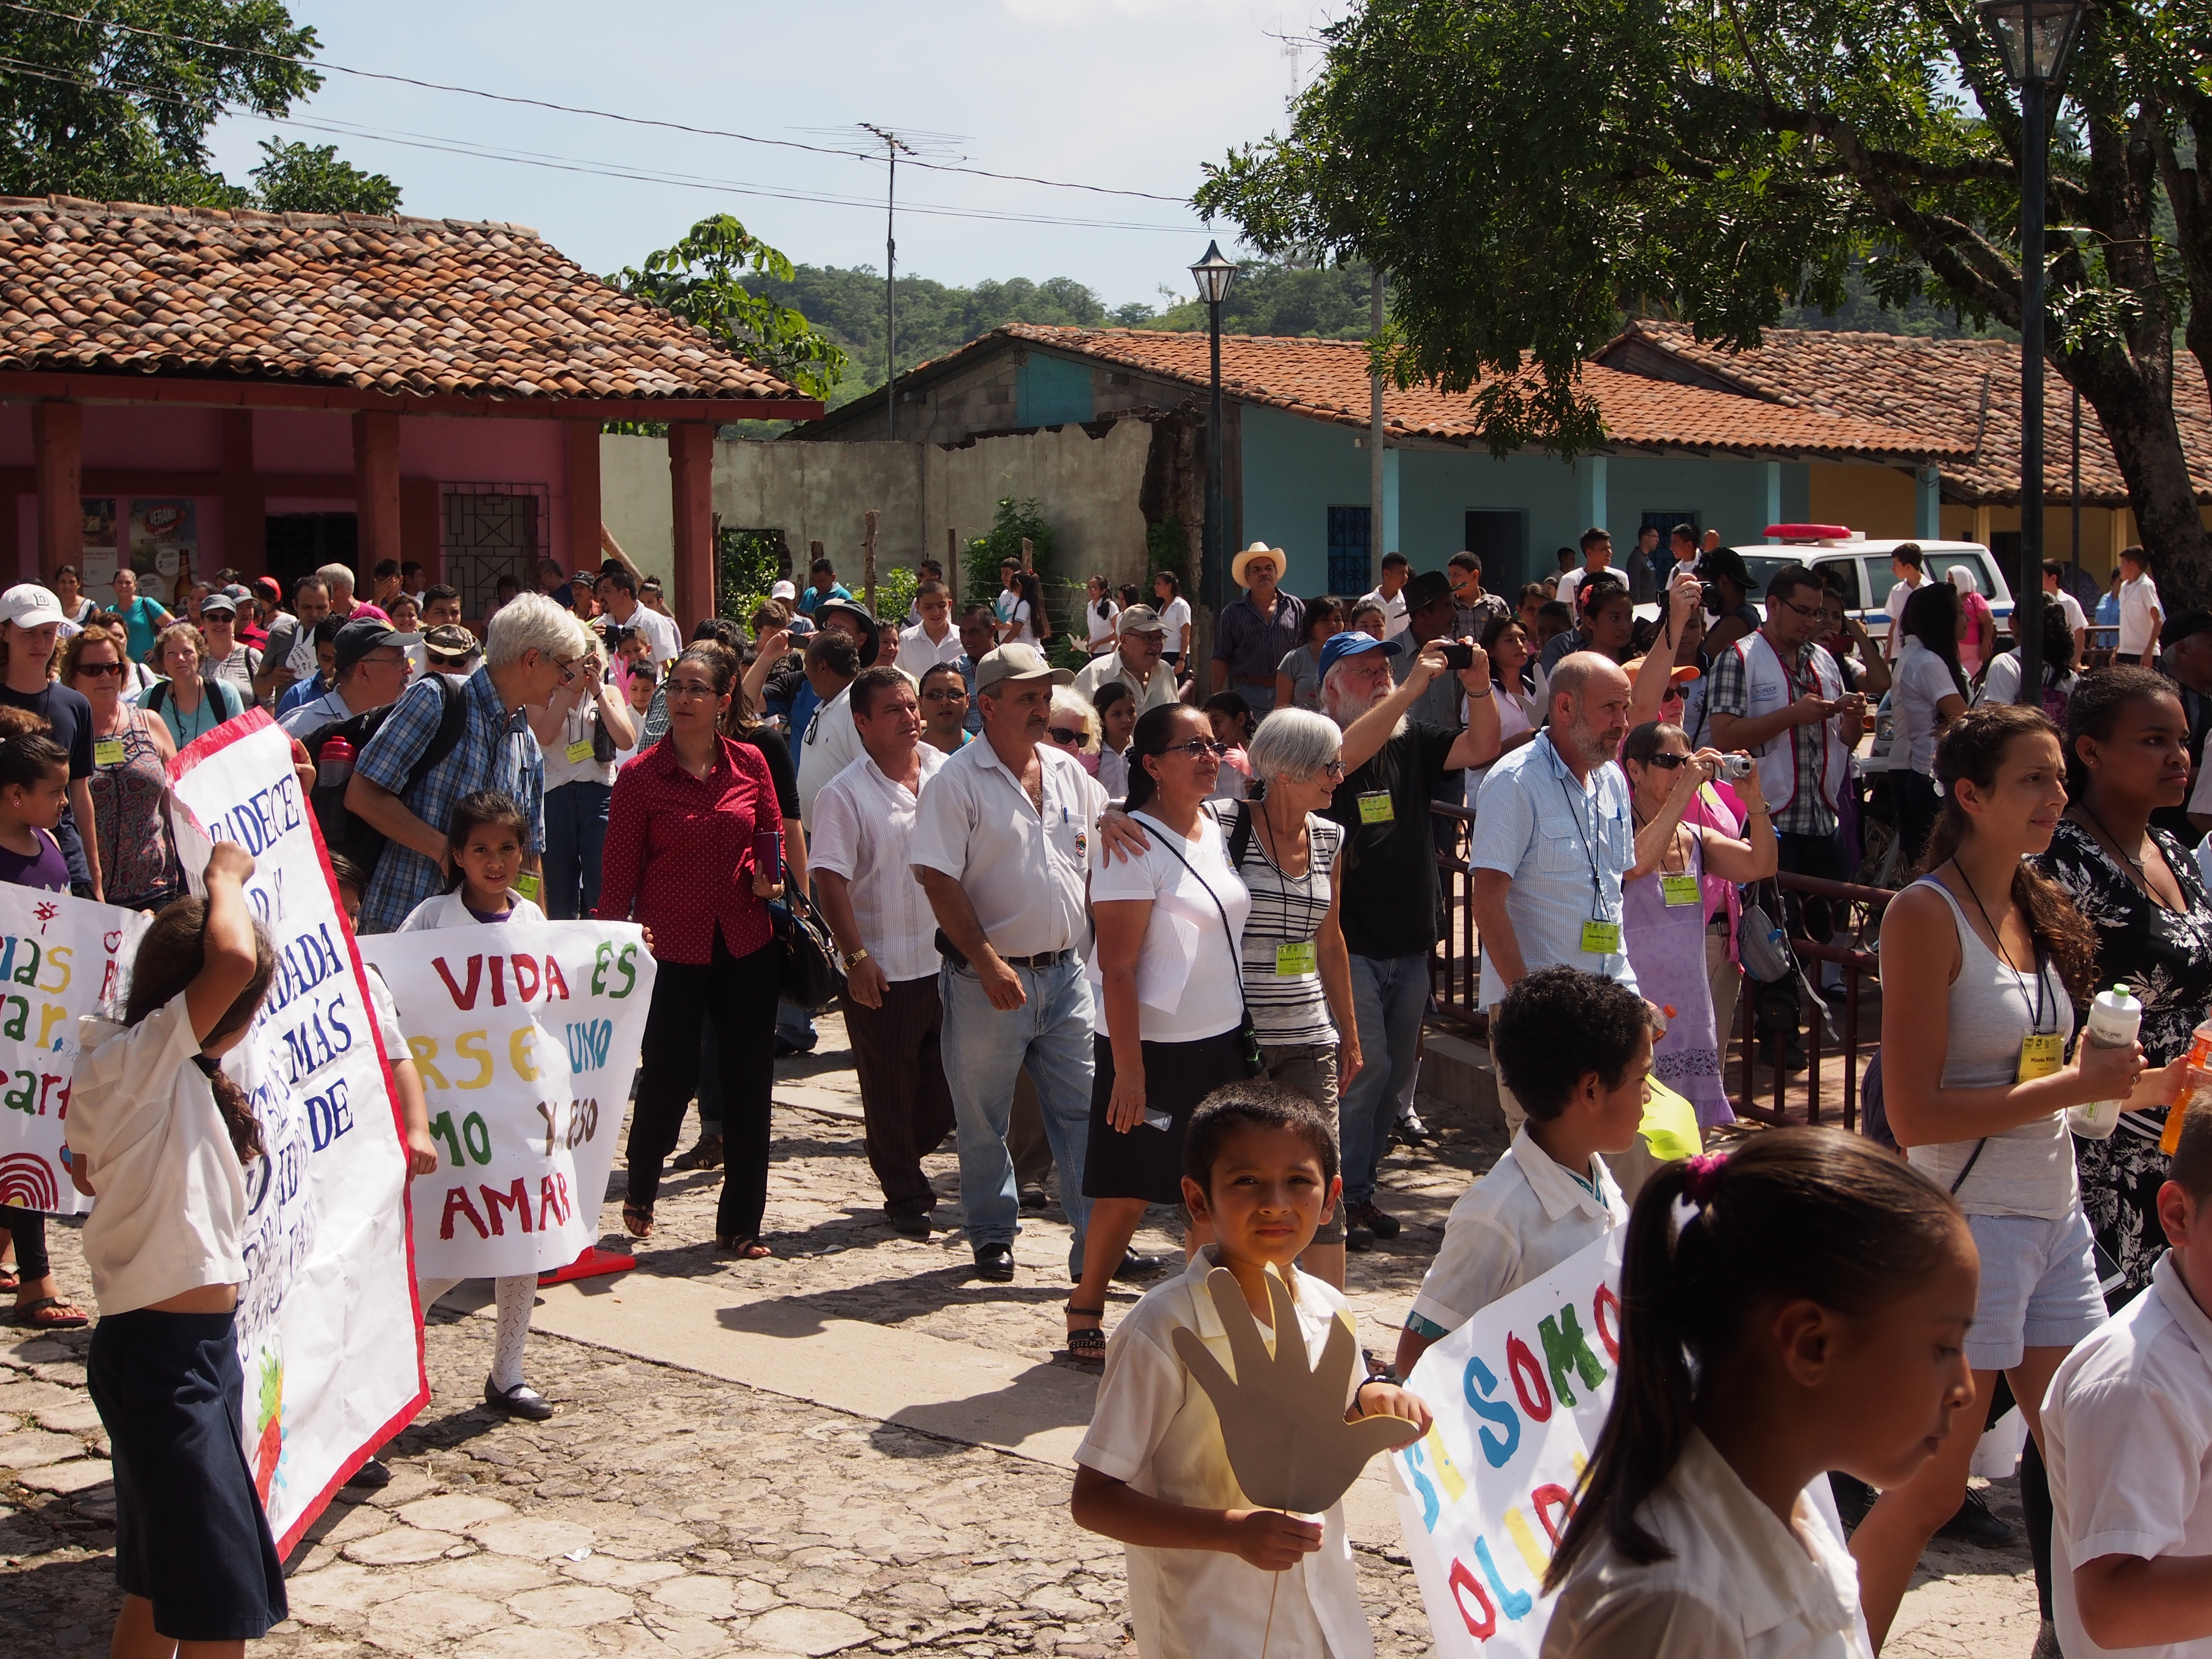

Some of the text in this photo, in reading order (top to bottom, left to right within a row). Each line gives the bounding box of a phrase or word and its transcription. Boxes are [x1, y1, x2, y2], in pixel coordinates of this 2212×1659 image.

[149, 507, 177, 526] VERANO
[33, 593, 49, 606] D
[431, 953, 570, 1011] VIDA
[591, 940, 637, 999] ES
[566, 1018, 613, 1074] UNO
[304, 1077, 354, 1154] DE
[537, 1097, 599, 1156] Y ESO
